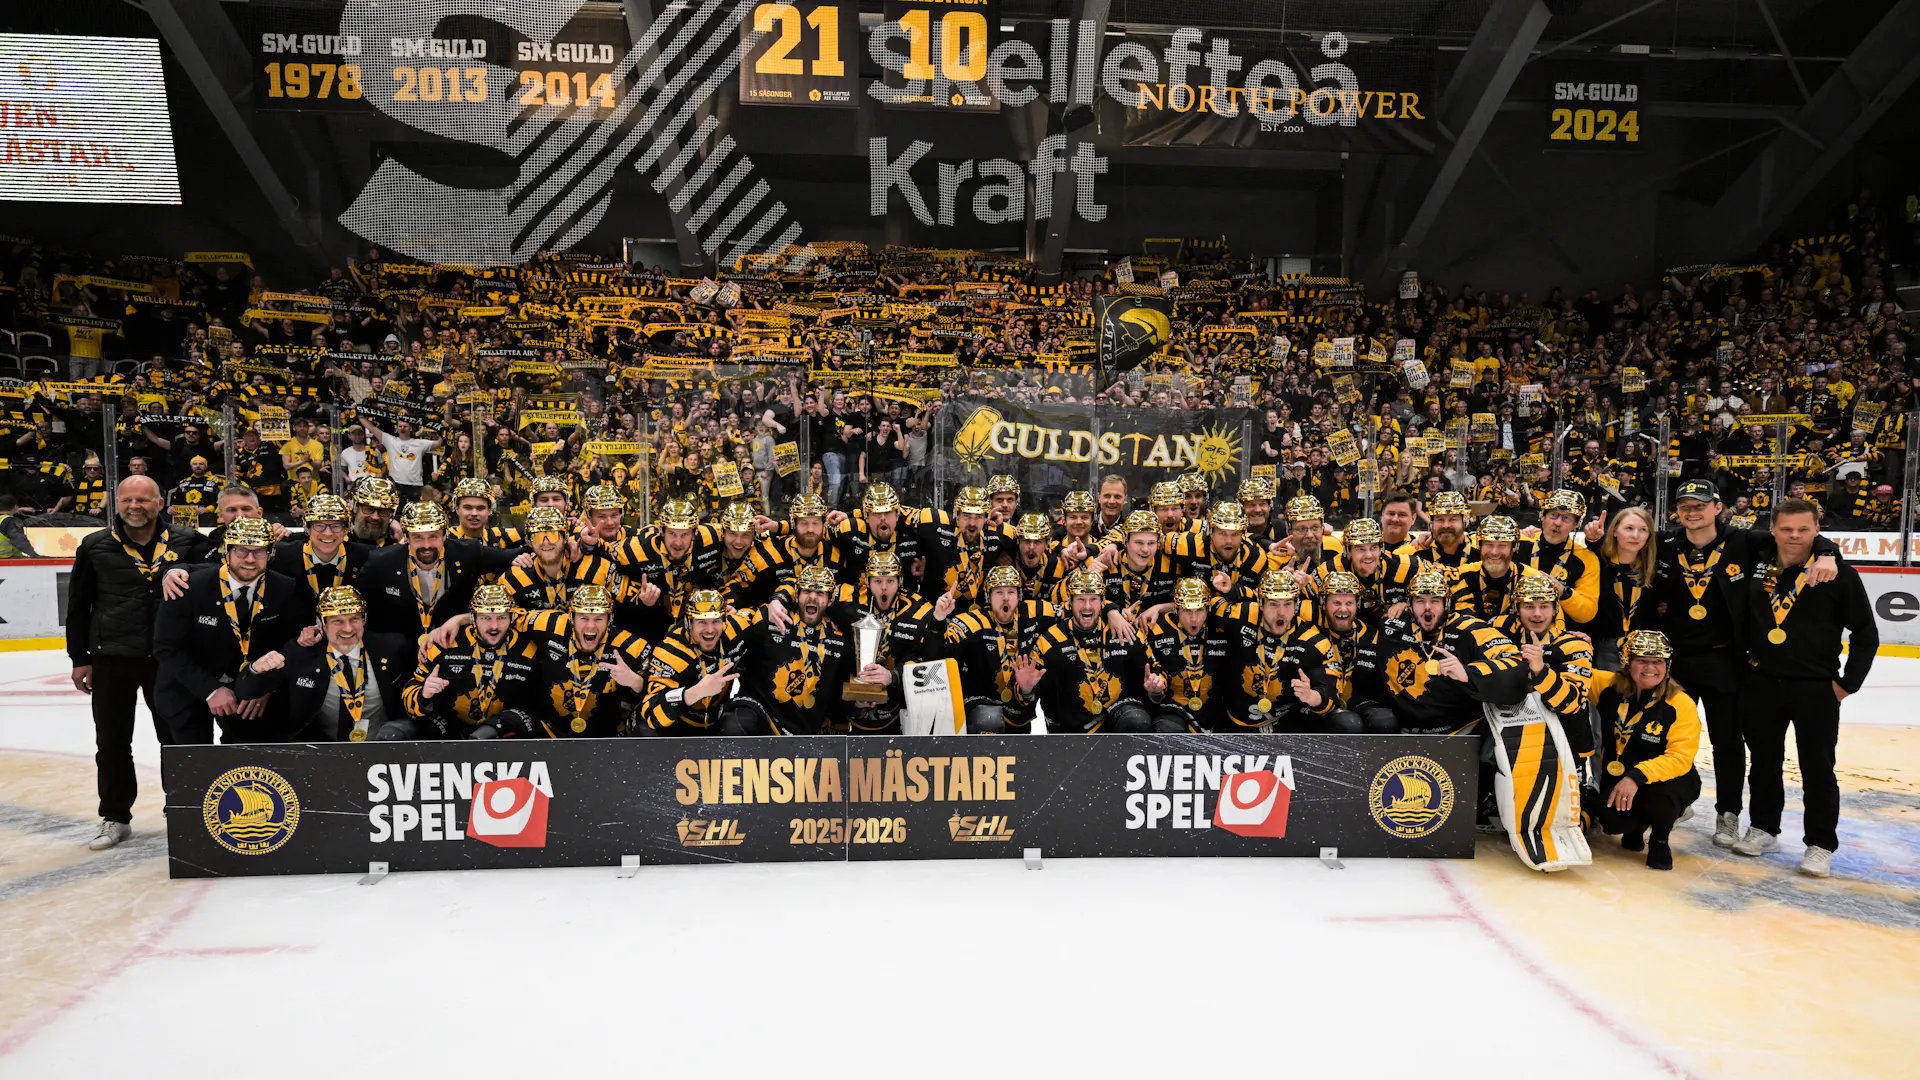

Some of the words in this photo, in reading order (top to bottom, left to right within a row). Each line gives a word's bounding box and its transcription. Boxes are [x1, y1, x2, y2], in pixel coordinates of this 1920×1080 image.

[261, 32, 362, 56] SM-GULD
[391, 38, 488, 60] SM-GULD
[517, 41, 615, 65] SM-GULD
[753, 4, 845, 77] 21
[896, 9, 988, 81] 10
[263, 62, 363, 99] 1978
[392, 67, 488, 103] 2013
[518, 70, 616, 108] 2014
[867, 18, 1359, 127] Skellefteå
[1136, 82, 1275, 117] NORTH
[1289, 85, 1426, 121] POWER
[1553, 82, 1639, 103] SM-GULD
[1550, 108, 1640, 142] 2024
[868, 133, 1109, 227] Kraft
[1334, 346, 1344, 354] SM
[1334, 354, 1352, 362] GULD
[1408, 371, 1427, 384] GULD
[674, 757, 842, 806] SVENSKA
[849, 749, 1016, 803] MÄSTARE
[1125, 793, 1212, 830] SPEL
[1567, 773, 1581, 824] CCM
[367, 804, 465, 843] SPEL
[684, 818, 748, 841] SHL
[789, 817, 907, 845] 2025/2026
[955, 815, 1016, 836] SHL
